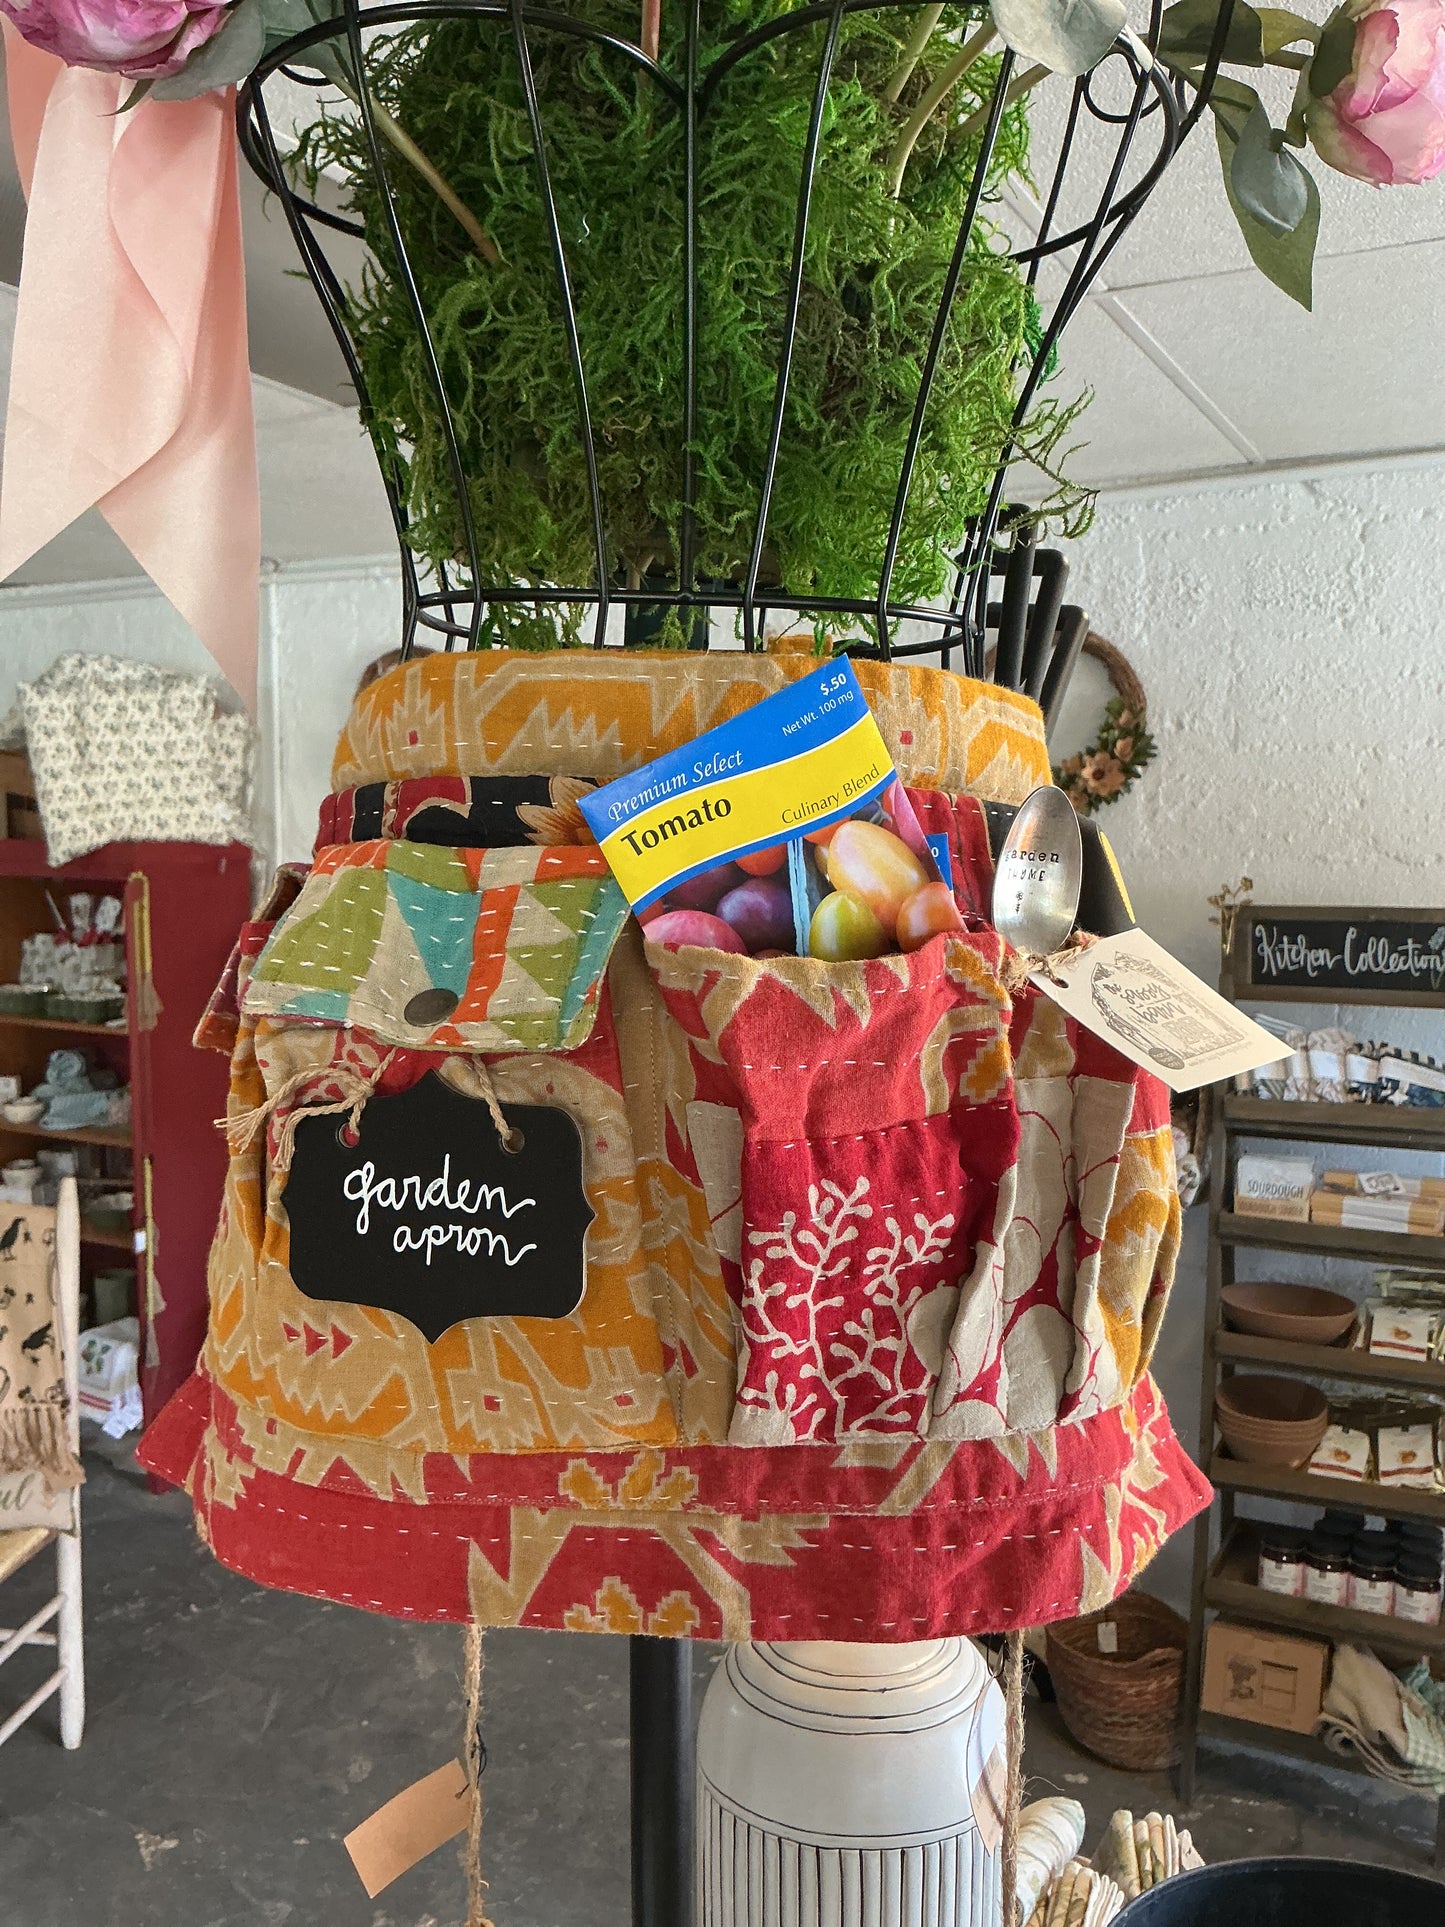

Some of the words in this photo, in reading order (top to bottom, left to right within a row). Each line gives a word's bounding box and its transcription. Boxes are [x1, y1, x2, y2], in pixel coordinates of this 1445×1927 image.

[819, 672, 848, 697] $.50
[782, 723, 802, 738] Net
[800, 710, 819, 728] Wt.
[818, 699, 837, 717] 100
[837, 690, 854, 711] mg
[607, 772, 688, 824] Premium
[692, 749, 744, 779] Select
[781, 793, 840, 825] Culinary
[842, 764, 880, 798] Blend
[620, 797, 732, 858] Tomato
[1254, 923, 1342, 977] Kitchen
[1129, 1001, 1187, 1024] barn
[343, 1153, 537, 1235] garden
[1247, 1178, 1305, 1199] SOURDOUGH
[393, 1223, 538, 1267] apron
